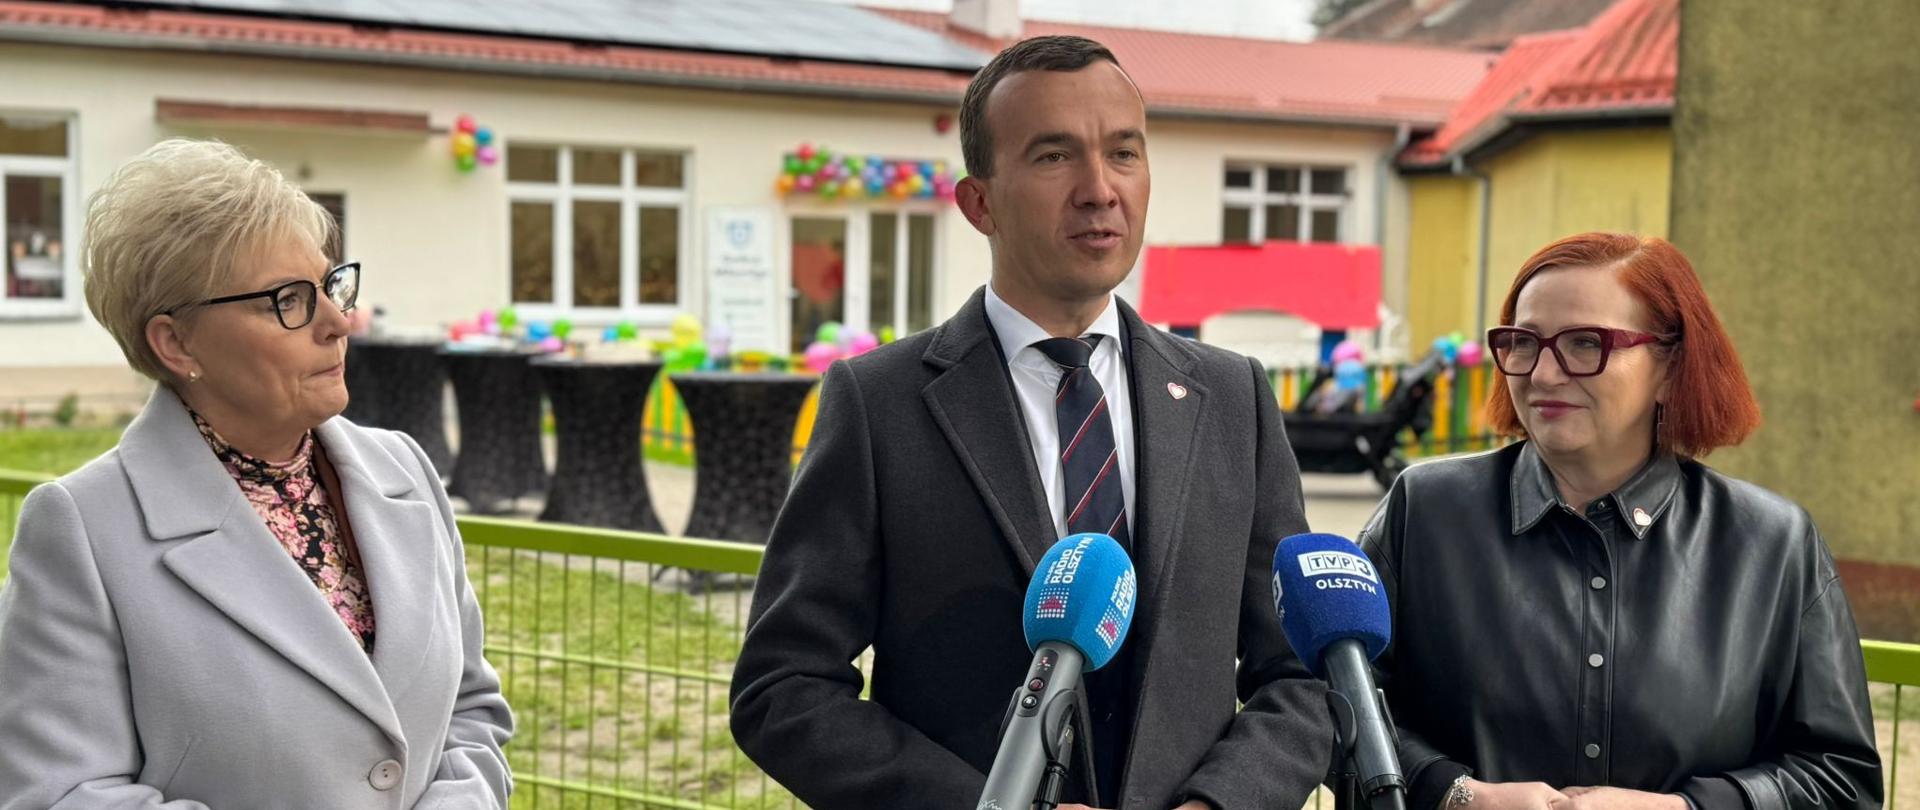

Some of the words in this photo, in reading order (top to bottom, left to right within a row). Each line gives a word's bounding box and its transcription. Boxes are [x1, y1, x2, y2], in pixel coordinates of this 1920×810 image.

[1050, 549, 1074, 584] RADIO
[1062, 536, 1094, 584] OLSZTYN
[1115, 569, 1131, 611] RADIO
[1315, 578, 1377, 596] OLSZTYN
